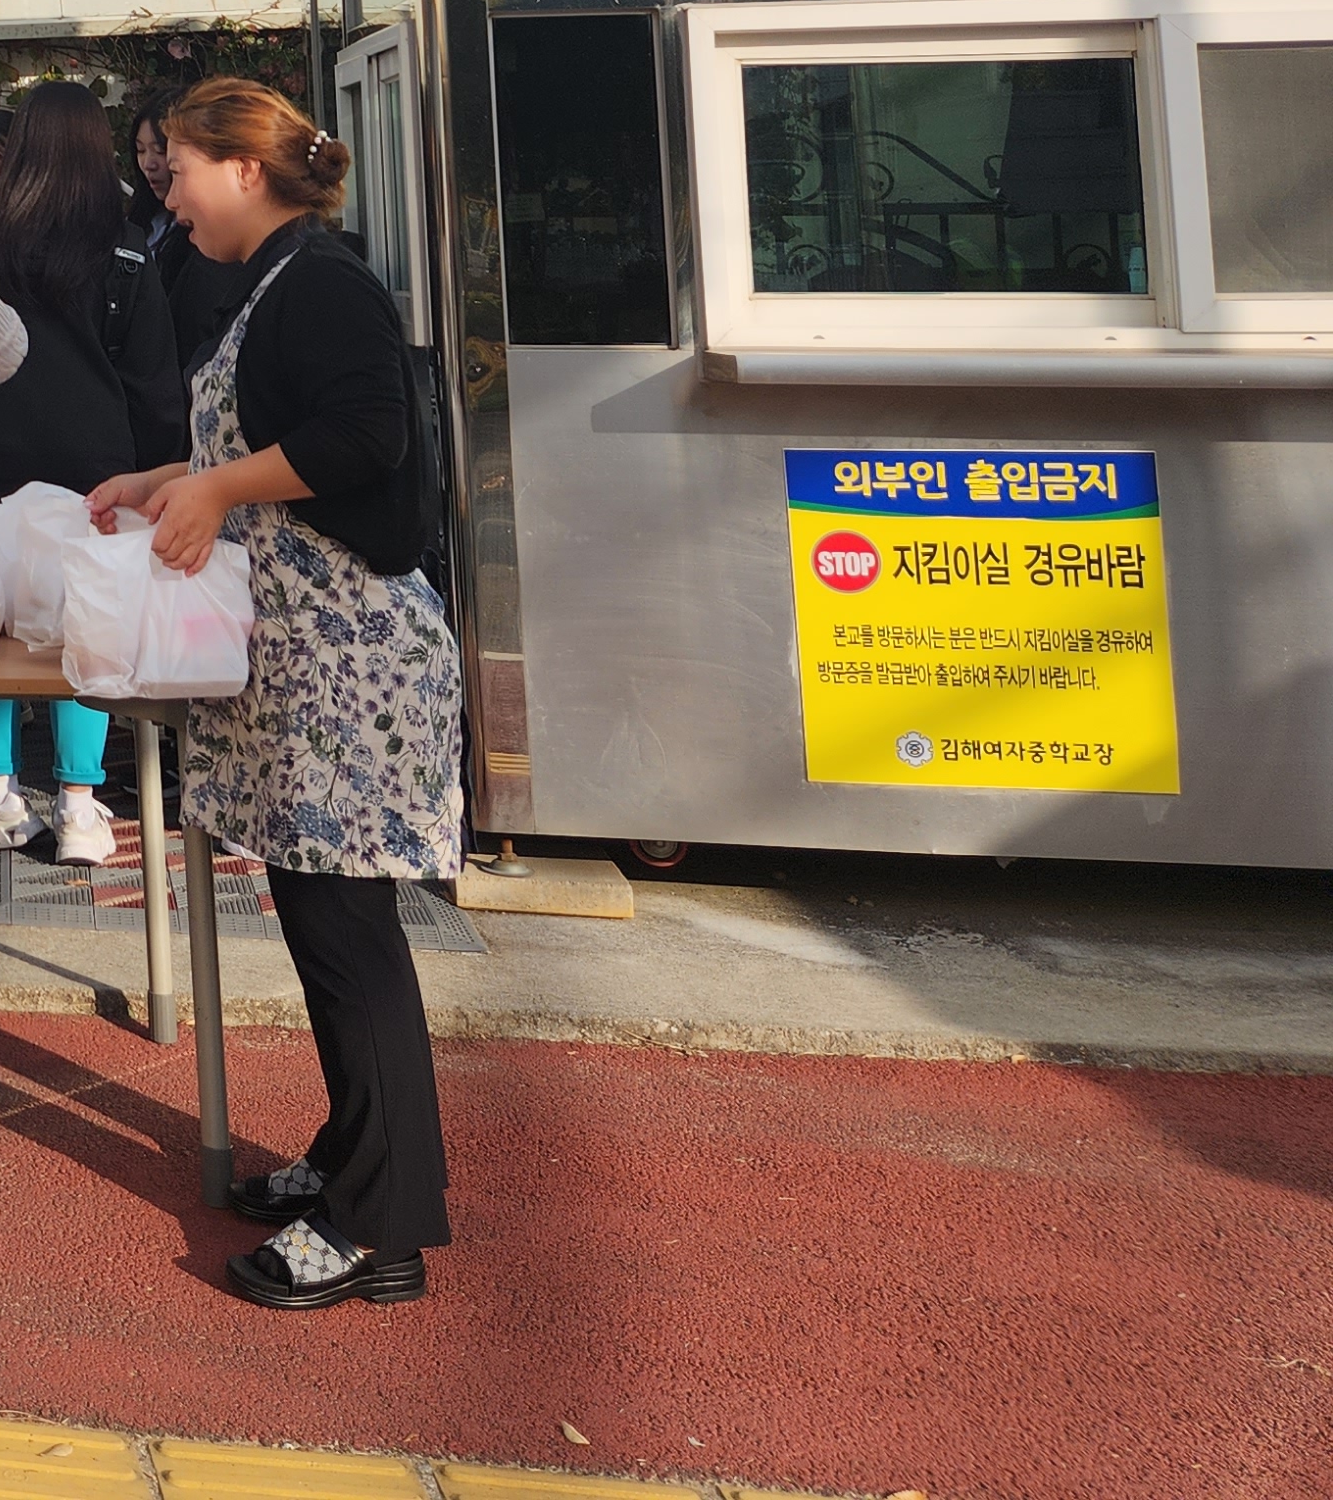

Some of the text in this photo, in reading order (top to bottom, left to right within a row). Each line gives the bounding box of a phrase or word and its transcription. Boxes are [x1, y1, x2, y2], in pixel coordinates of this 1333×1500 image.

[834, 459, 1118, 502] 외부인 출입금지
[817, 550, 876, 576] STOP
[892, 540, 1146, 589] 지킴이실 경유바람
[833, 624, 1154, 654] 본교를 방문하시는 분은 반드시 지킴이실을 경유하여
[817, 661, 1100, 691] 방문증을 발급받아 출입하여 주시기 바랍니다.
[940, 738, 1114, 766] 김해여자중학교장
